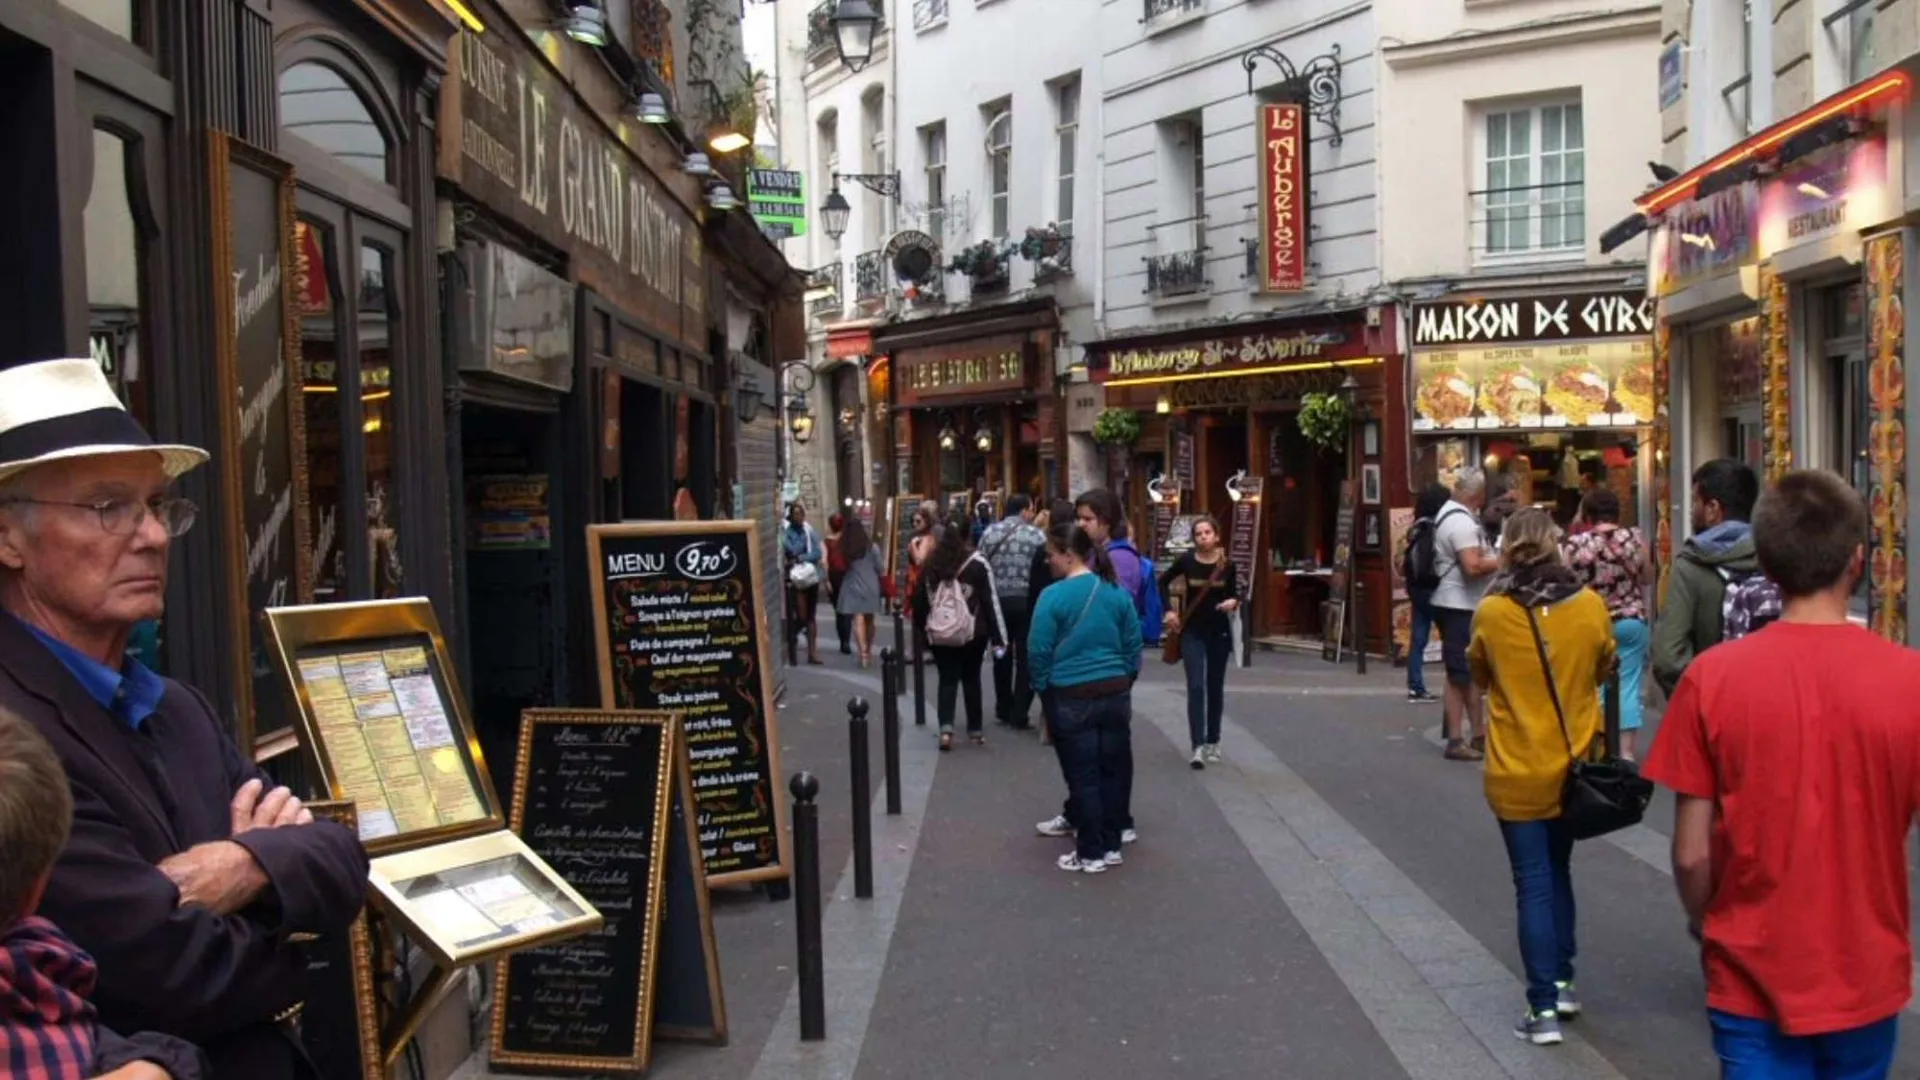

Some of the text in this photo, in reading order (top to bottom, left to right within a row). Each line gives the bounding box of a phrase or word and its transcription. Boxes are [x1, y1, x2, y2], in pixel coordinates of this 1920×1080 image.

[517, 72, 548, 216] LE
[559, 115, 624, 263] GRAND
[1415, 301, 1519, 343] MAISON
[1534, 298, 1570, 336] DE
[607, 552, 666, 574] MENU
